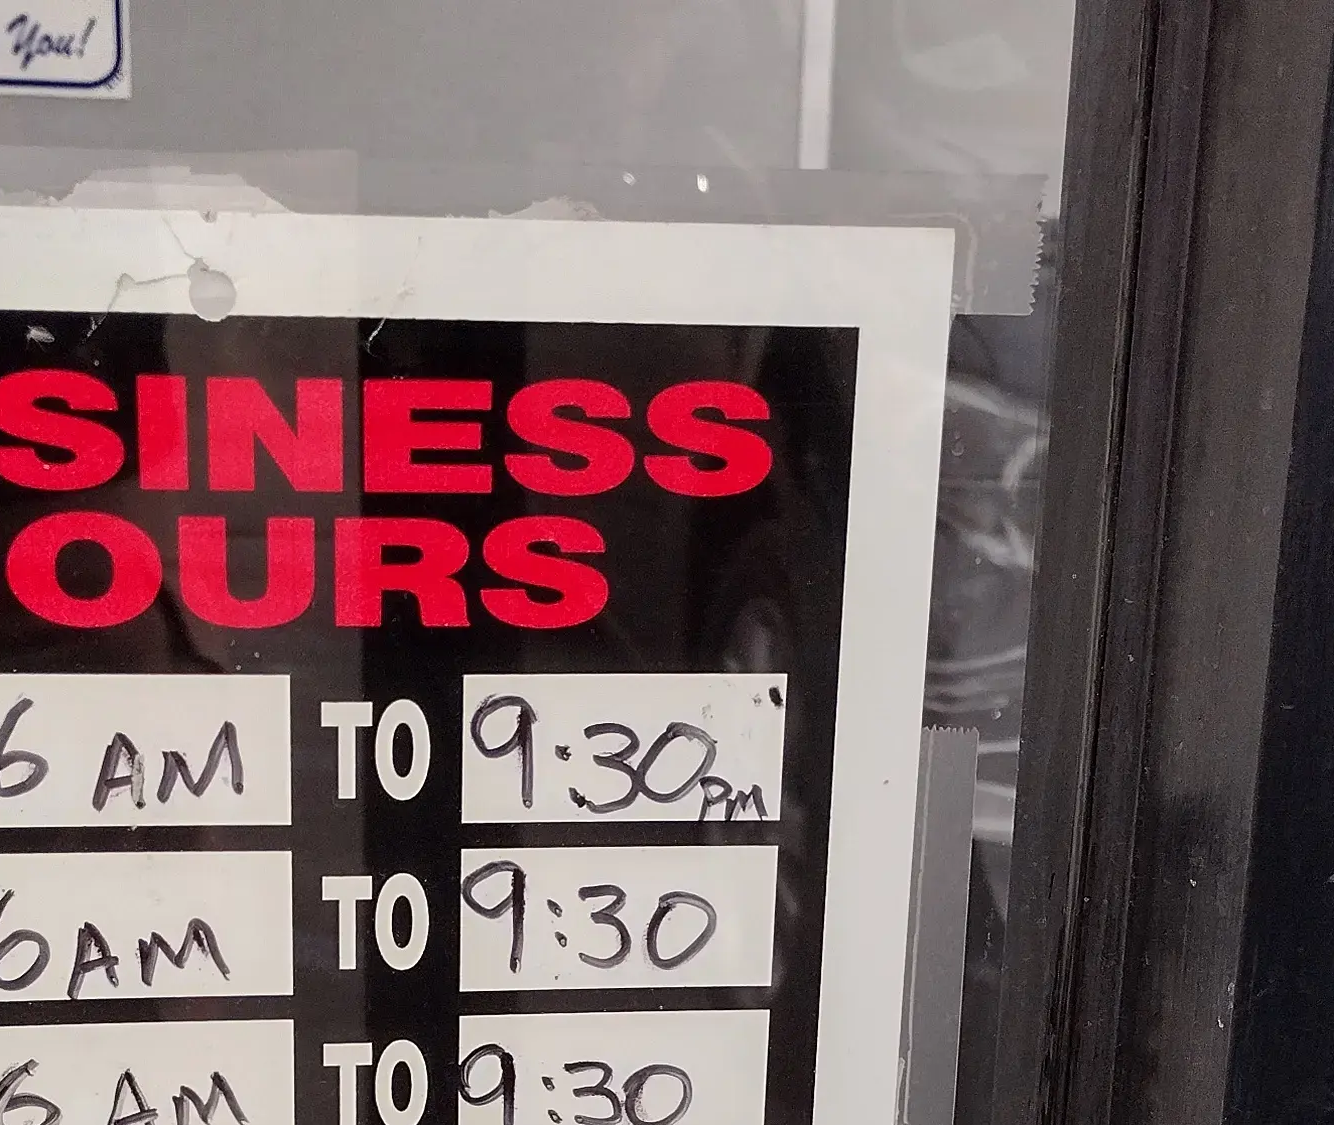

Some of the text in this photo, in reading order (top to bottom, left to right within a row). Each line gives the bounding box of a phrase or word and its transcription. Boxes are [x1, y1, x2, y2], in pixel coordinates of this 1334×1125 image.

[6, 14, 97, 71] You!
[94, 721, 244, 812] AM
[320, 699, 431, 801] TO
[68, 918, 231, 999] AM
[321, 872, 430, 971] TO
[462, 860, 717, 973] 9:30
